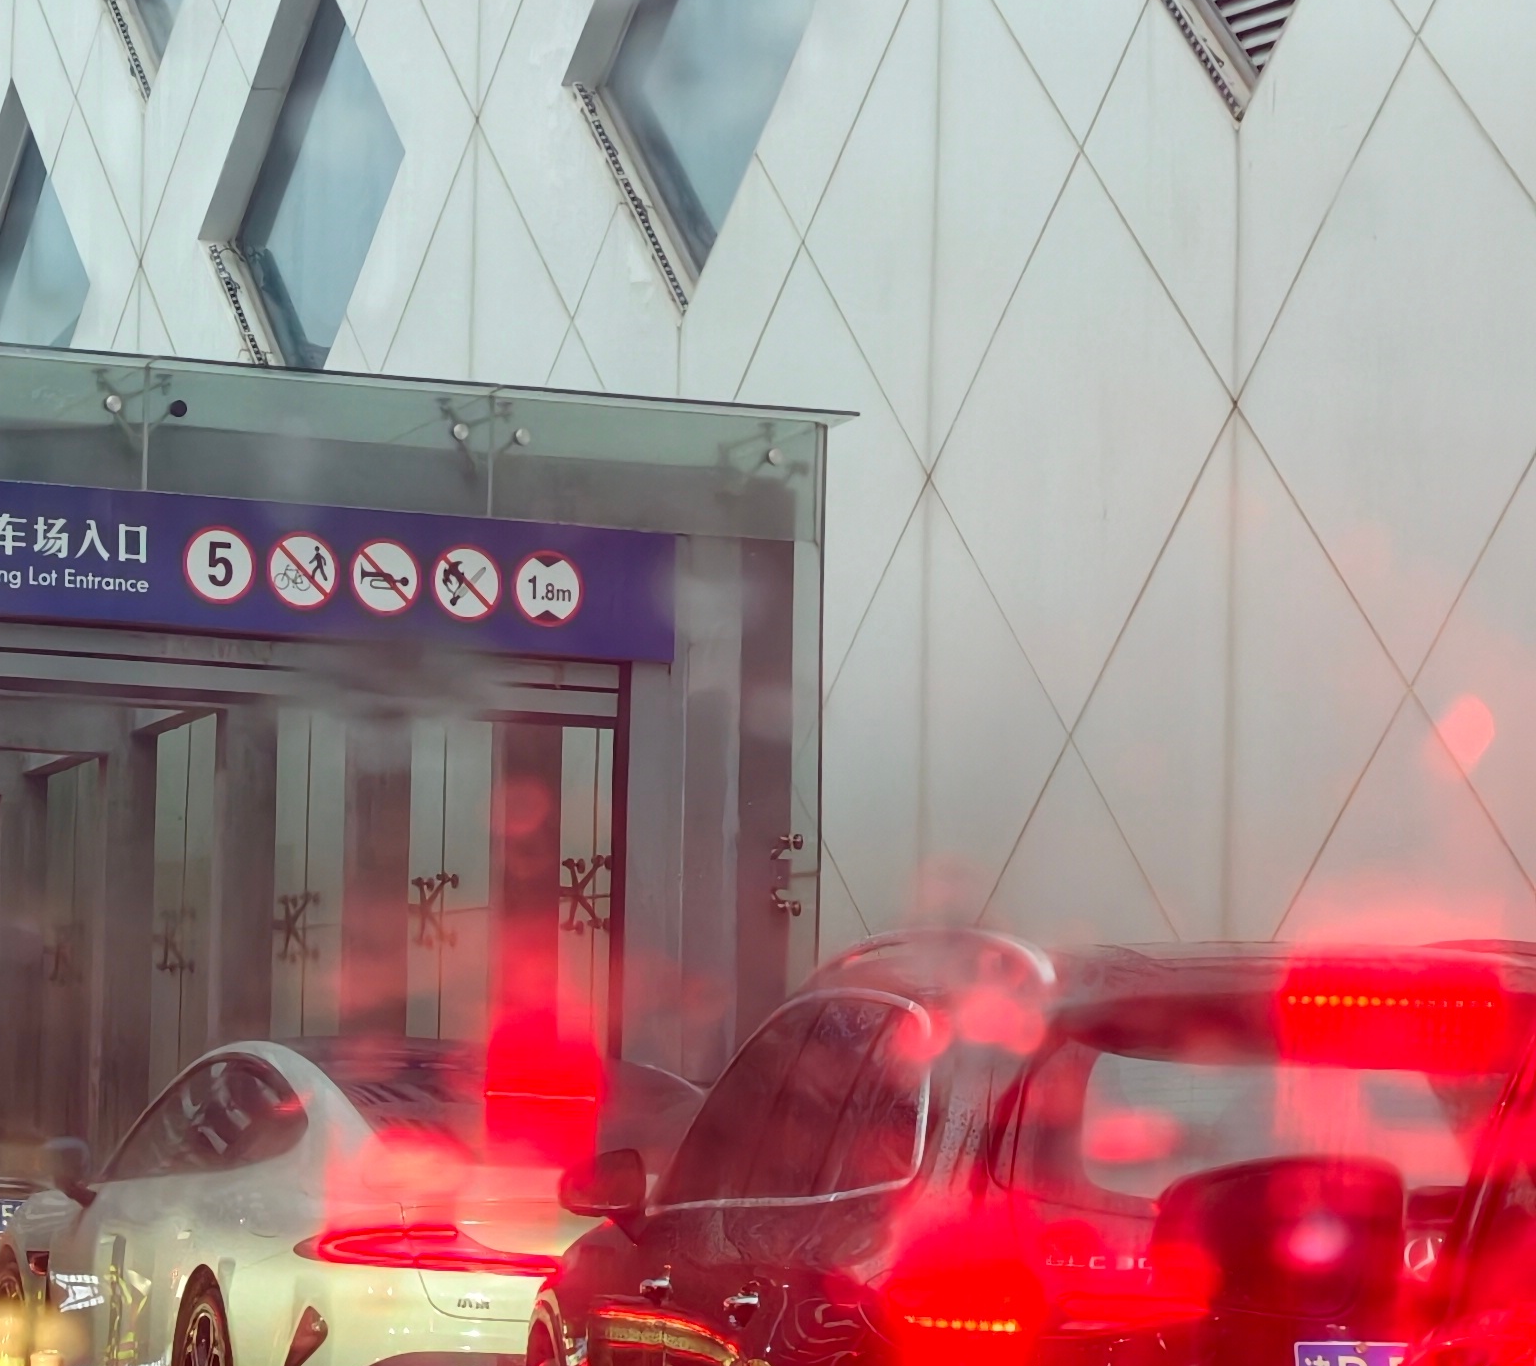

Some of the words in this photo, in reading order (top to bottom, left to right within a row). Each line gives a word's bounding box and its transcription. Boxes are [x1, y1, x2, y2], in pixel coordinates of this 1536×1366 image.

[208, 541, 233, 587] 5
[28, 566, 58, 587] Lot
[64, 569, 150, 593] Entrance
[528, 575, 572, 603] 1.8m
